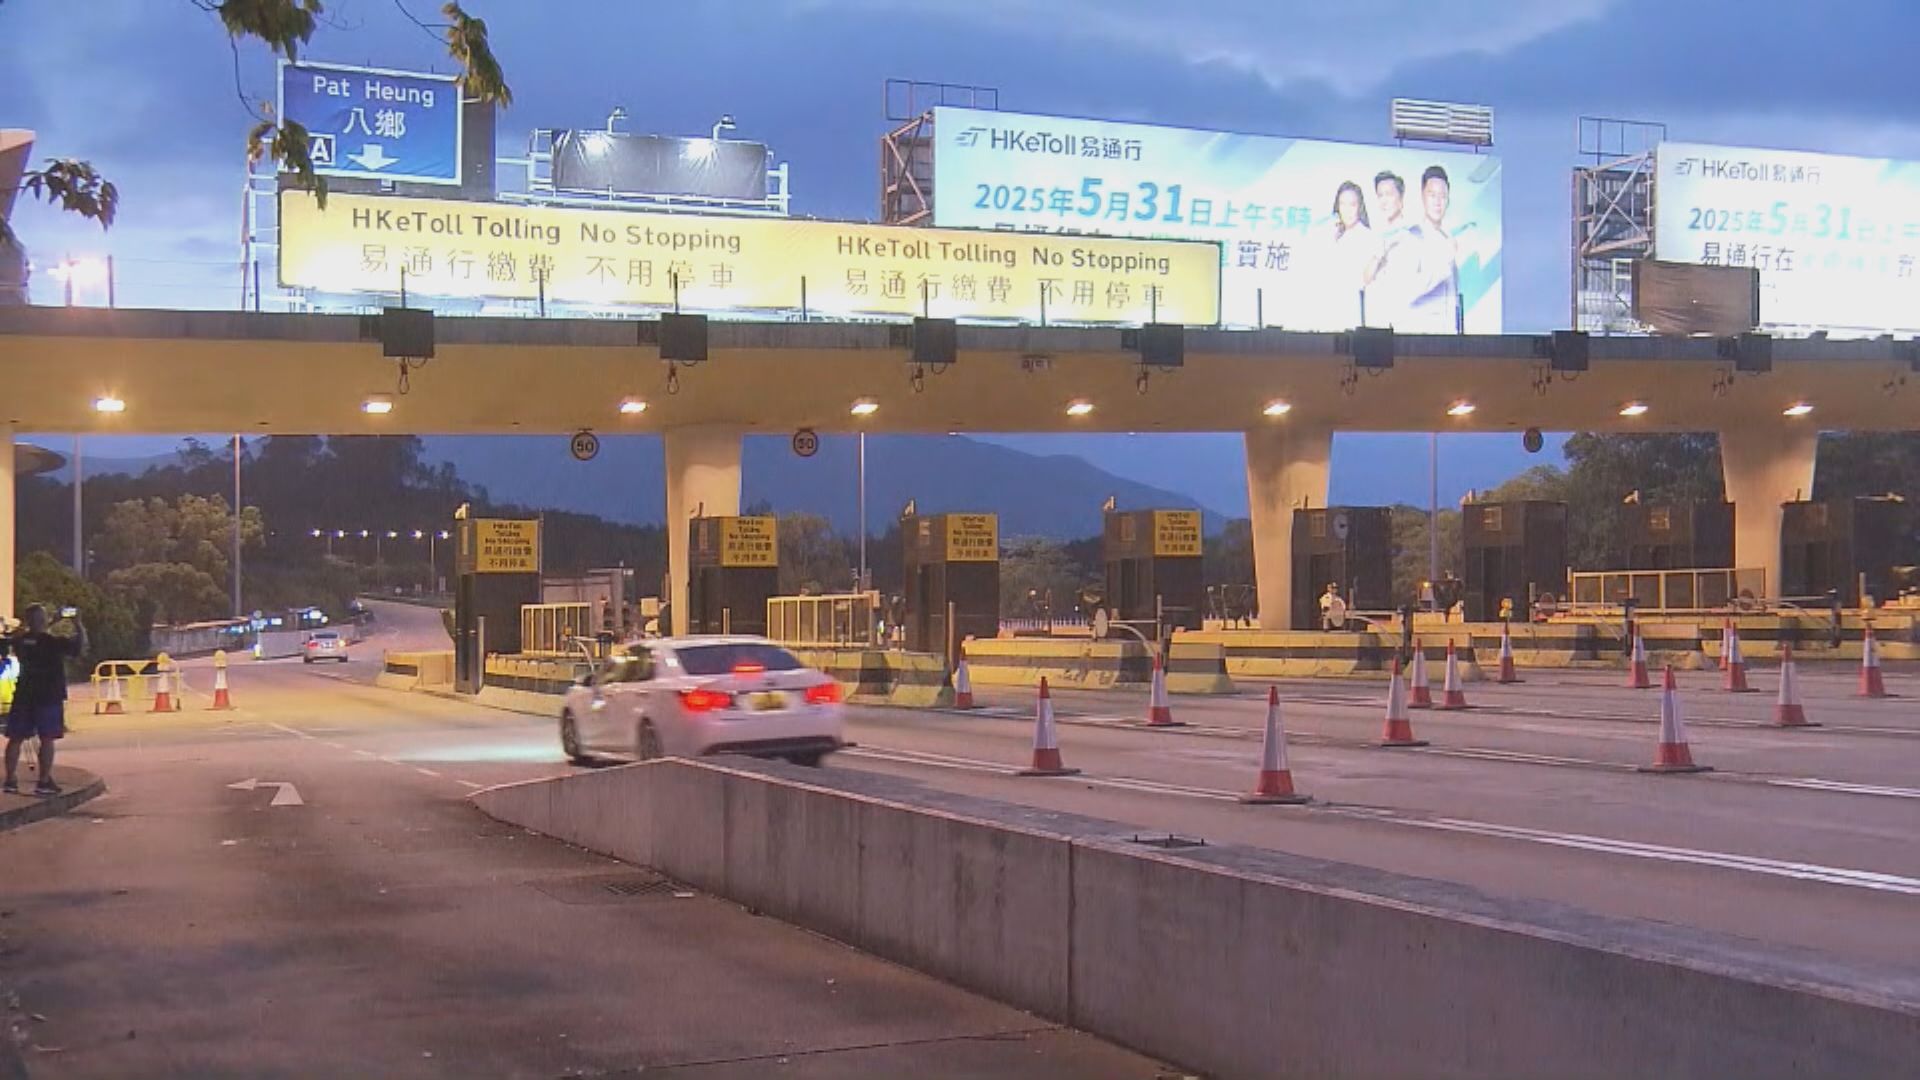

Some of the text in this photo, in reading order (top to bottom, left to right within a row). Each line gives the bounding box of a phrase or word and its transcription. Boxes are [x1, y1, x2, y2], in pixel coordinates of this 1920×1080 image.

[313, 75, 435, 108] Pat Heung
[343, 107, 406, 139] 八鄉
[309, 138, 330, 162] A
[990, 127, 1142, 161] HKeToll 易通行
[1702, 158, 1768, 182] HKeToll
[352, 207, 741, 254] HKeToll Tolling No Stopping
[837, 235, 1170, 275] HKeToll Tolling No Stopping
[587, 255, 735, 290] 不用停車
[577, 440, 593, 453] 50
